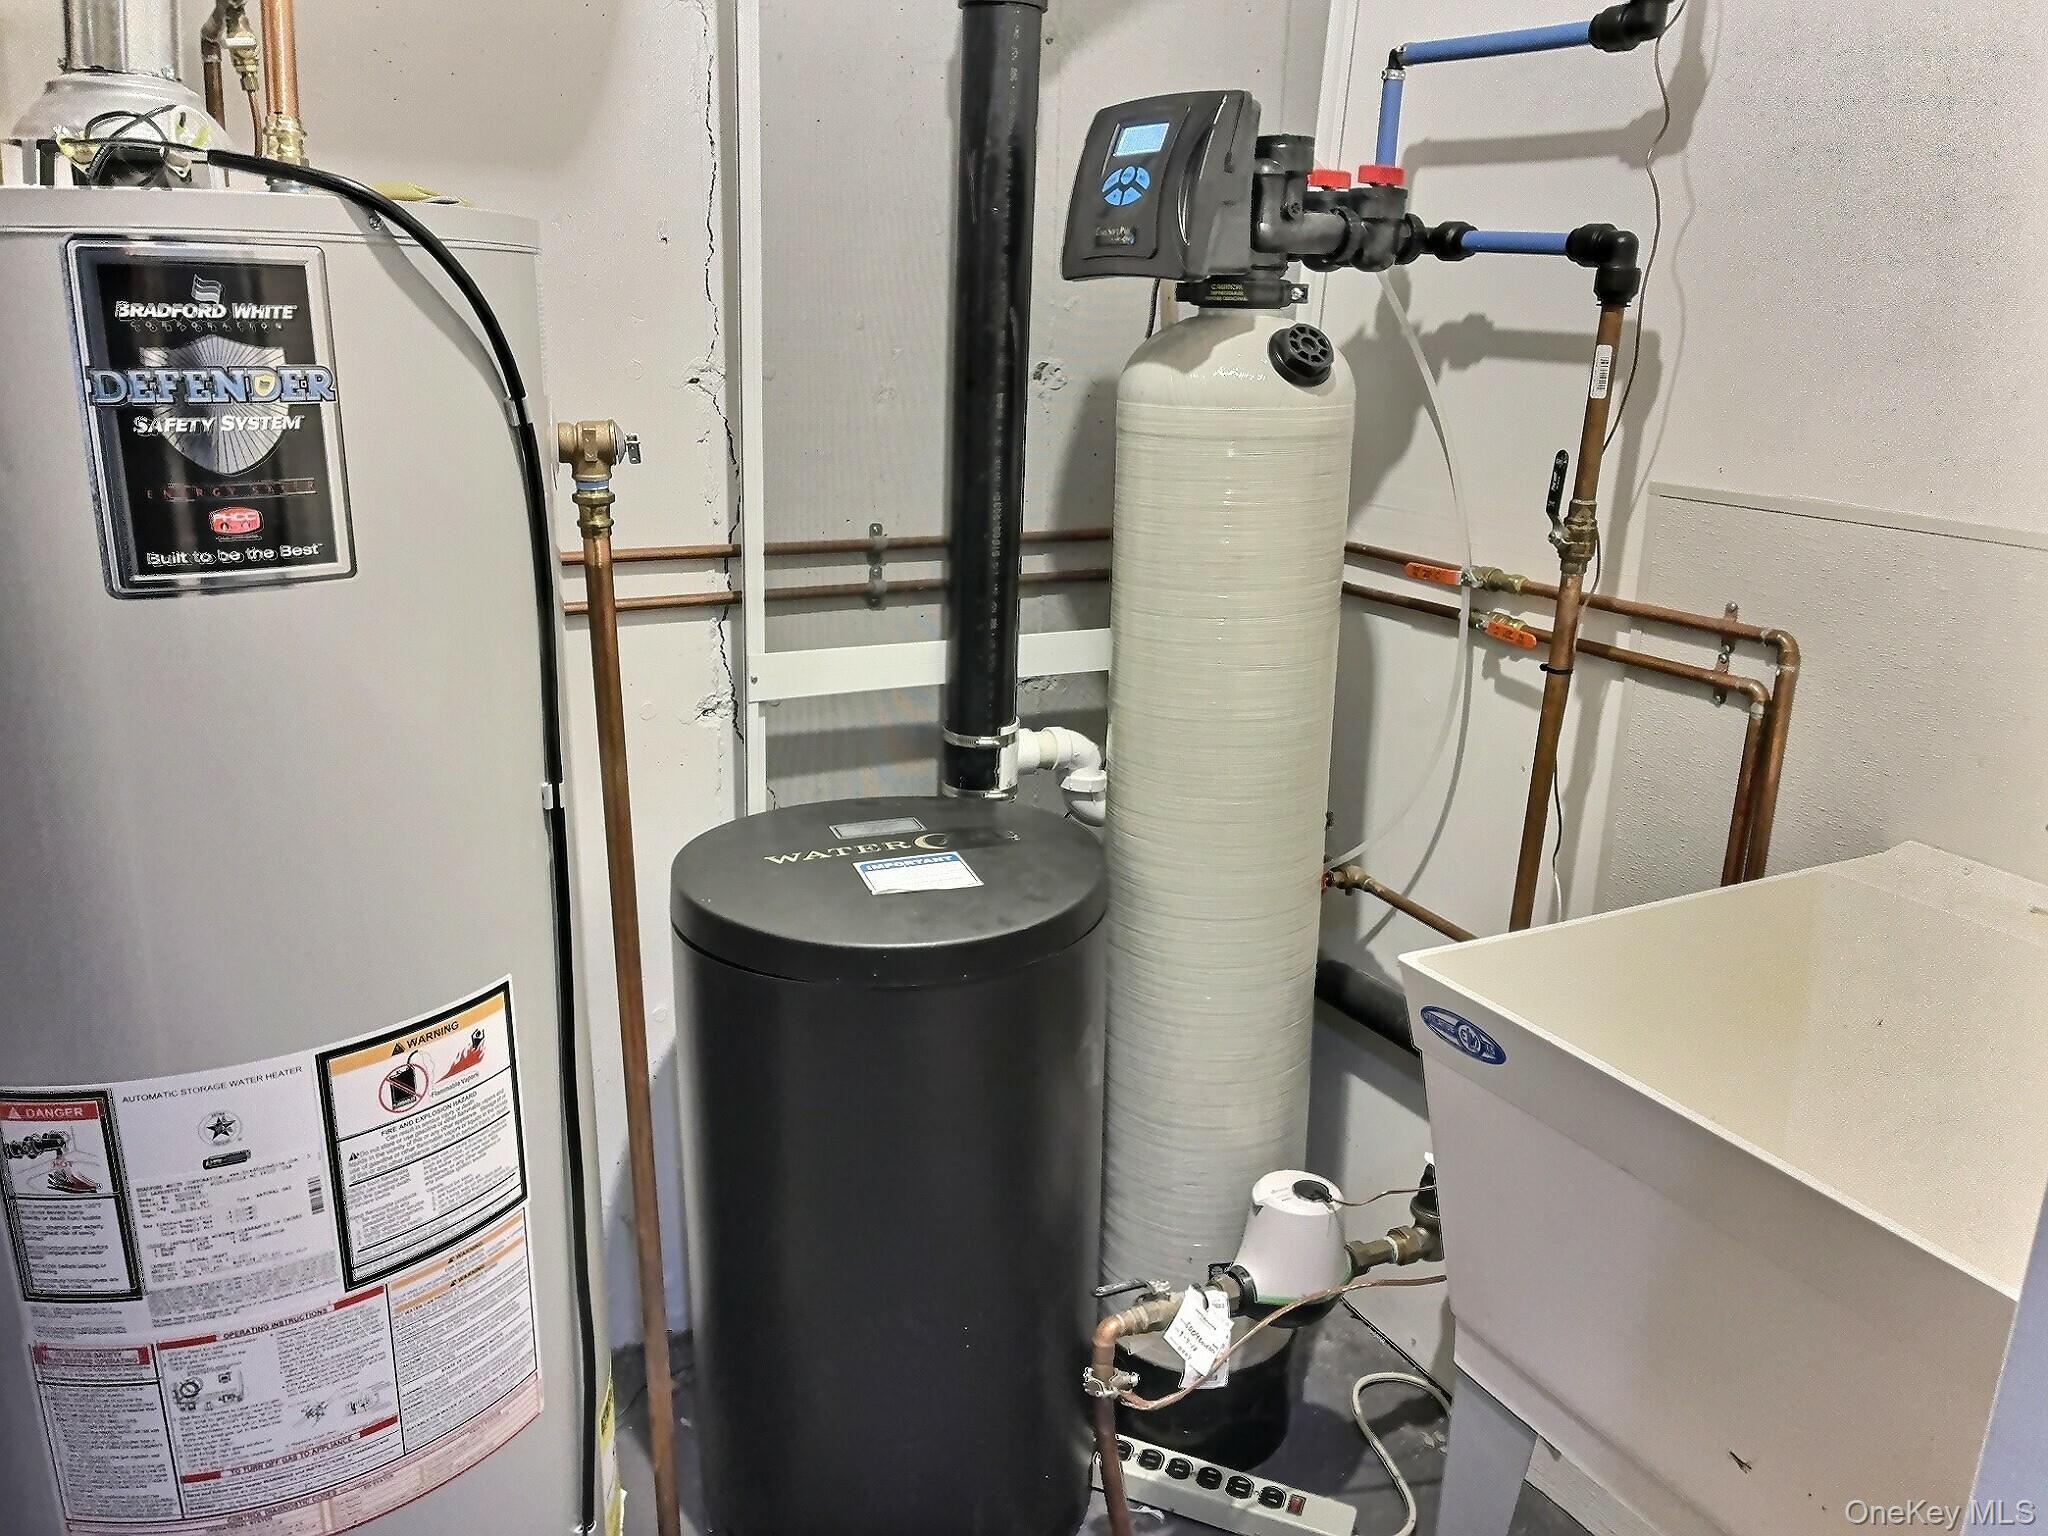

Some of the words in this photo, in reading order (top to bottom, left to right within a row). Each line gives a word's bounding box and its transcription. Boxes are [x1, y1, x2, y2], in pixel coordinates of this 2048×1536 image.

[115, 301, 226, 319] BRADFORD
[232, 304, 294, 320] WHITE
[90, 366, 336, 405] DEFENDER
[134, 416, 214, 435] SAFETY
[221, 415, 301, 432] SYSTEM
[147, 551, 187, 566] Built
[192, 552, 213, 564] to
[217, 549, 241, 563] be
[246, 546, 275, 560] the
[279, 544, 320, 558] Best
[865, 855, 954, 872] IMPORTANT
[407, 1021, 460, 1049] WARNING
[122, 1088, 179, 1103] AUTOMATIC
[180, 1082, 228, 1096] STORAGE
[229, 1074, 264, 1088] WATER
[265, 1065, 303, 1081] HEATER
[25, 1107, 84, 1118] DANGER
[380, 1126, 397, 1137] FIRE
[399, 1119, 415, 1130] AND
[415, 1101, 452, 1124] EXPLOSION
[452, 1090, 478, 1108] HAZARD
[223, 1324, 270, 1340] OPERATING
[270, 1307, 329, 1330] INSTRUCTIONS
[230, 1468, 241, 1476] TO
[300, 1451, 311, 1460] TO
